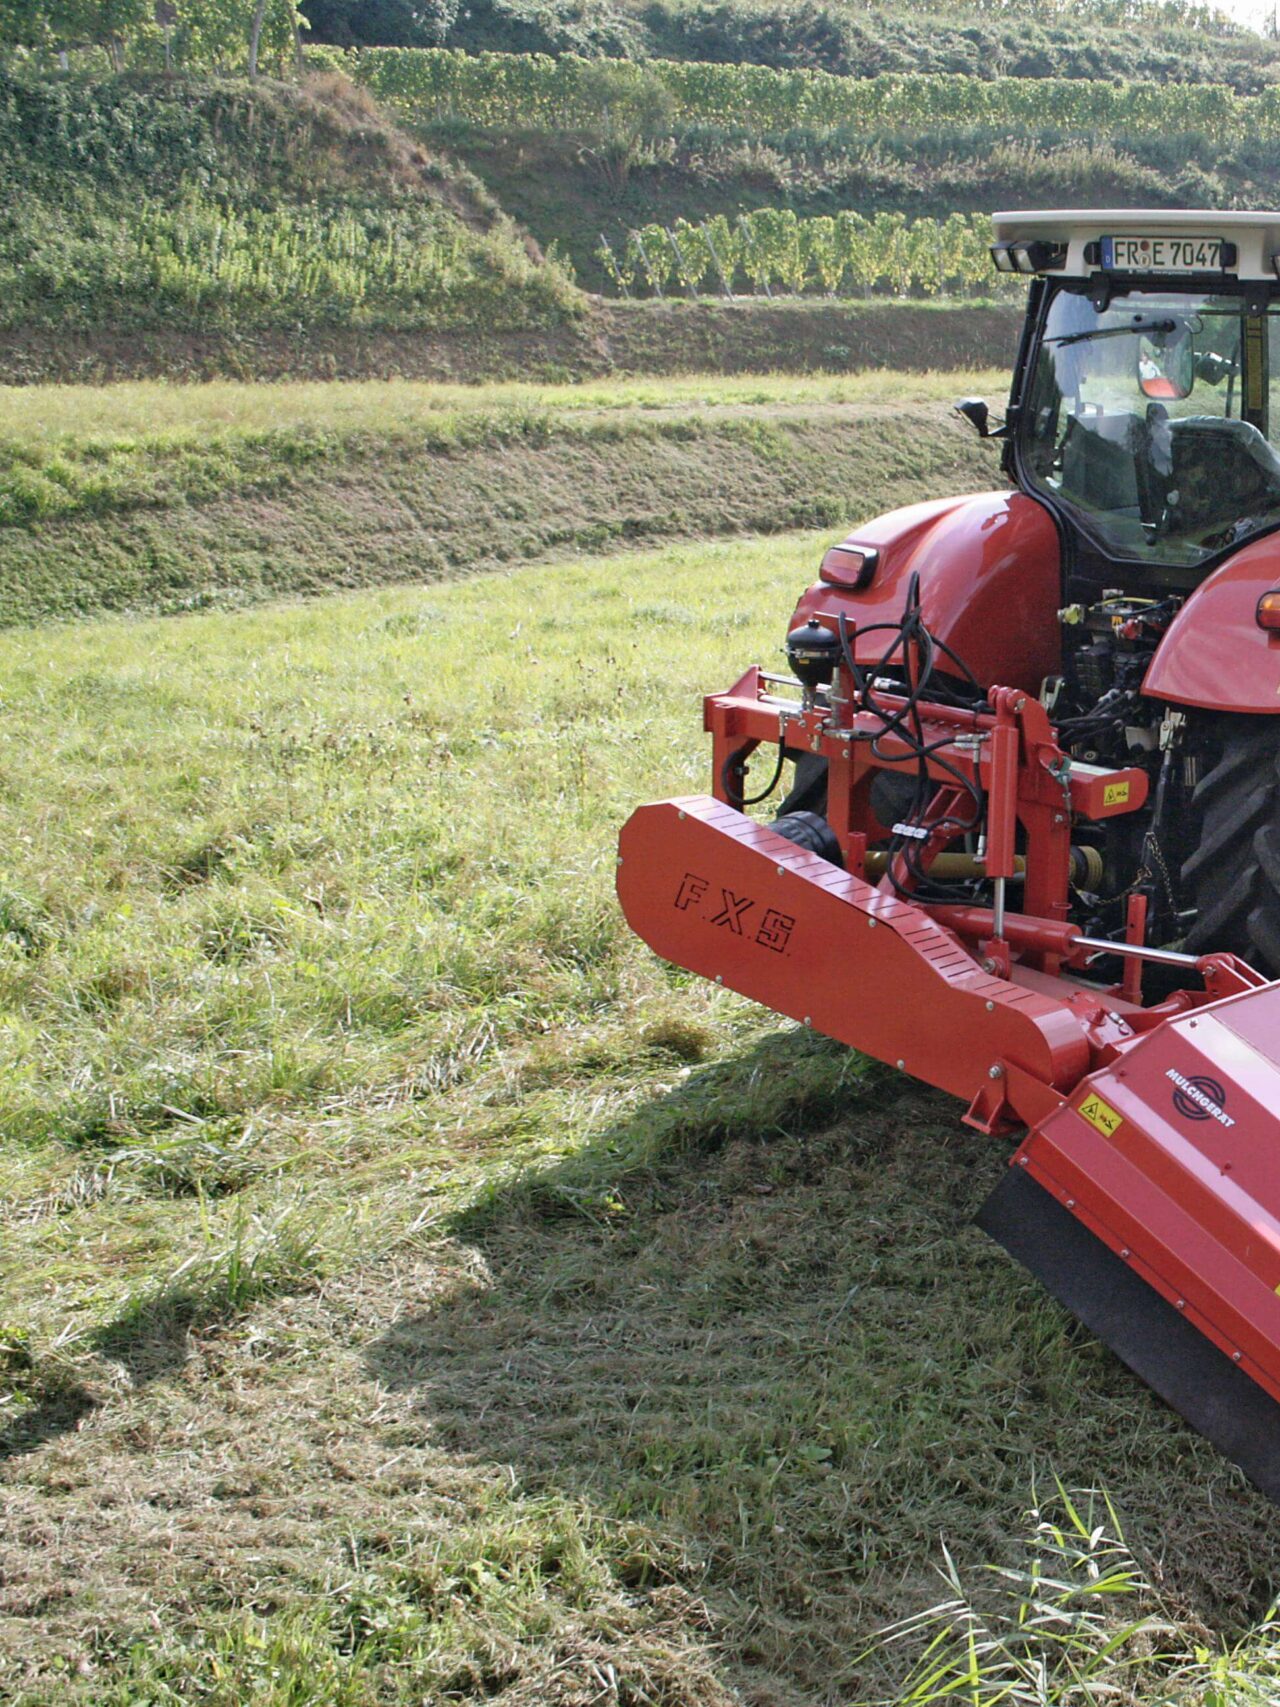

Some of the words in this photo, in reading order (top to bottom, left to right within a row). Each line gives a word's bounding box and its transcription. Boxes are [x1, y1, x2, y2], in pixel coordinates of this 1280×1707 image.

[1114, 242, 1138, 265] FR
[1153, 242, 1165, 266] E
[1170, 243, 1220, 266] 7047
